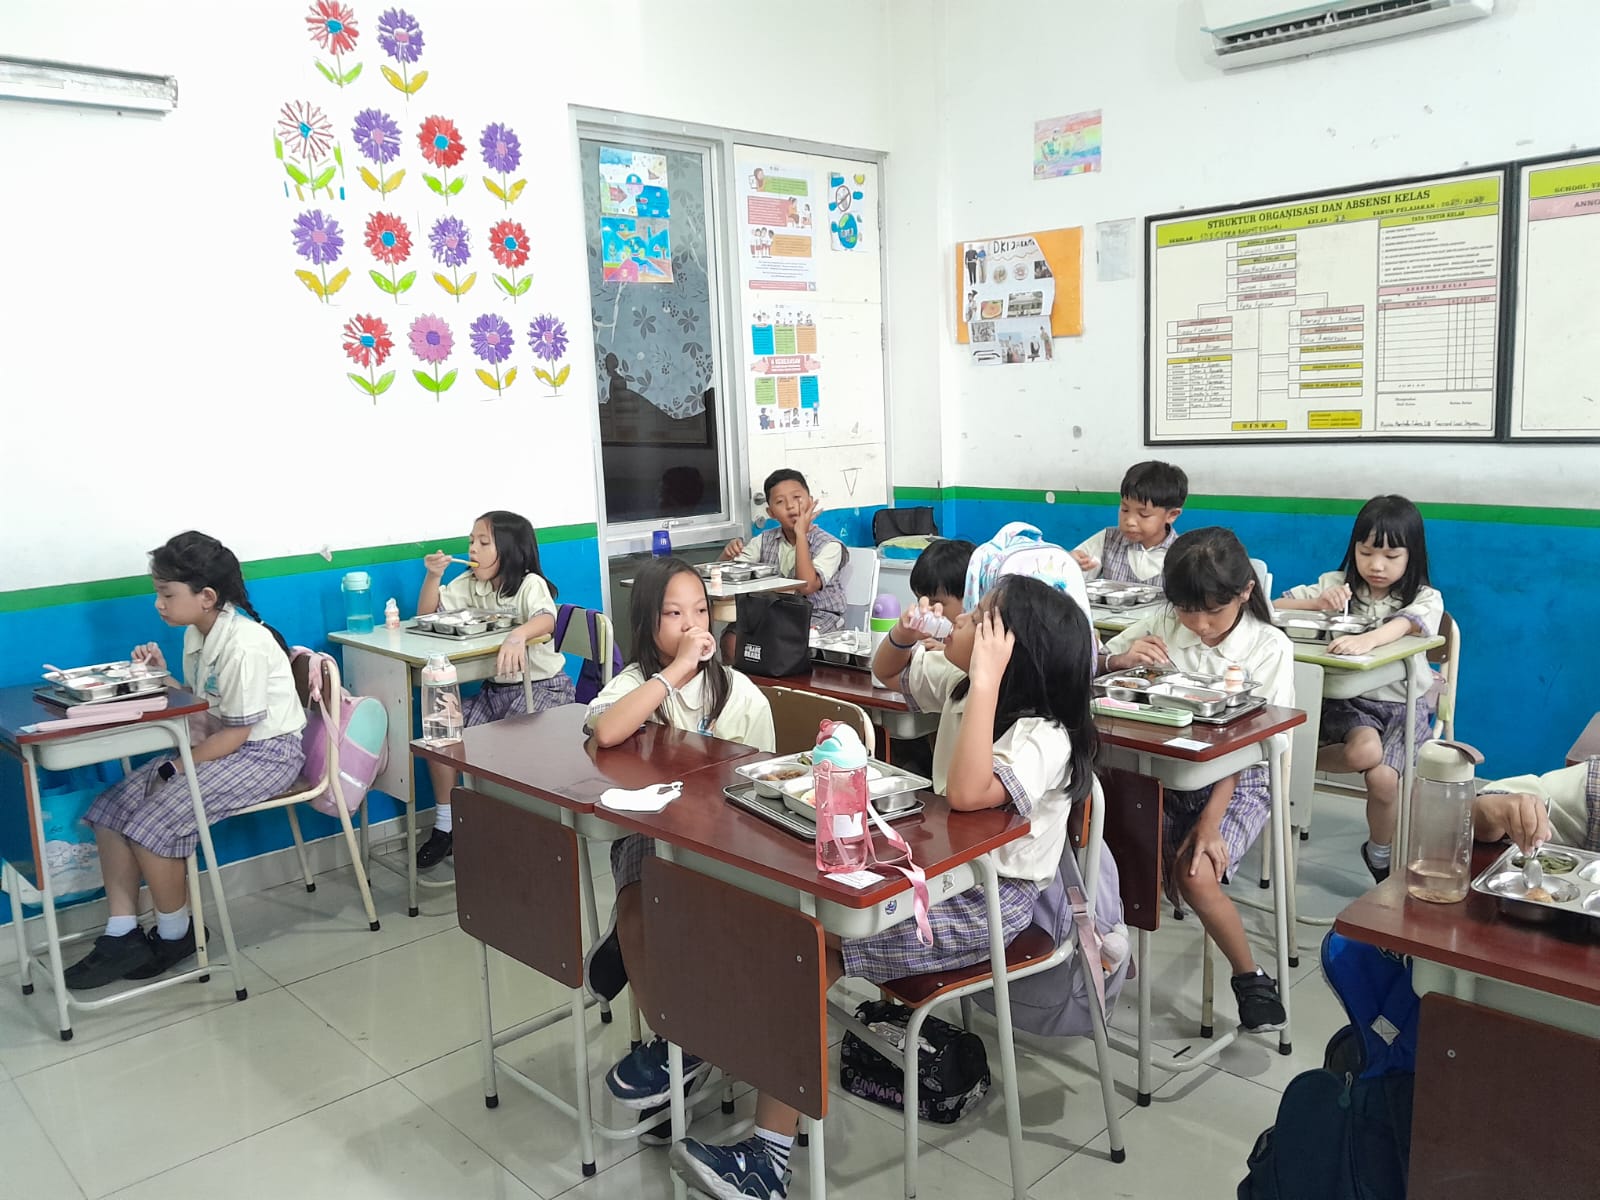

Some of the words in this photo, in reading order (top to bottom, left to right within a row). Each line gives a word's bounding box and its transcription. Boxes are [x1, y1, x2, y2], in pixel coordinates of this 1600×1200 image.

[1554, 184, 1589, 193] SCHOOL
[1207, 214, 1256, 229] STRUKTUR
[1259, 204, 1319, 221] ORGANISASI
[1322, 202, 1343, 213] DAN
[1345, 195, 1392, 210] ABSENSI
[1394, 189, 1431, 203] KELAS
[993, 240, 1009, 254] DKI
